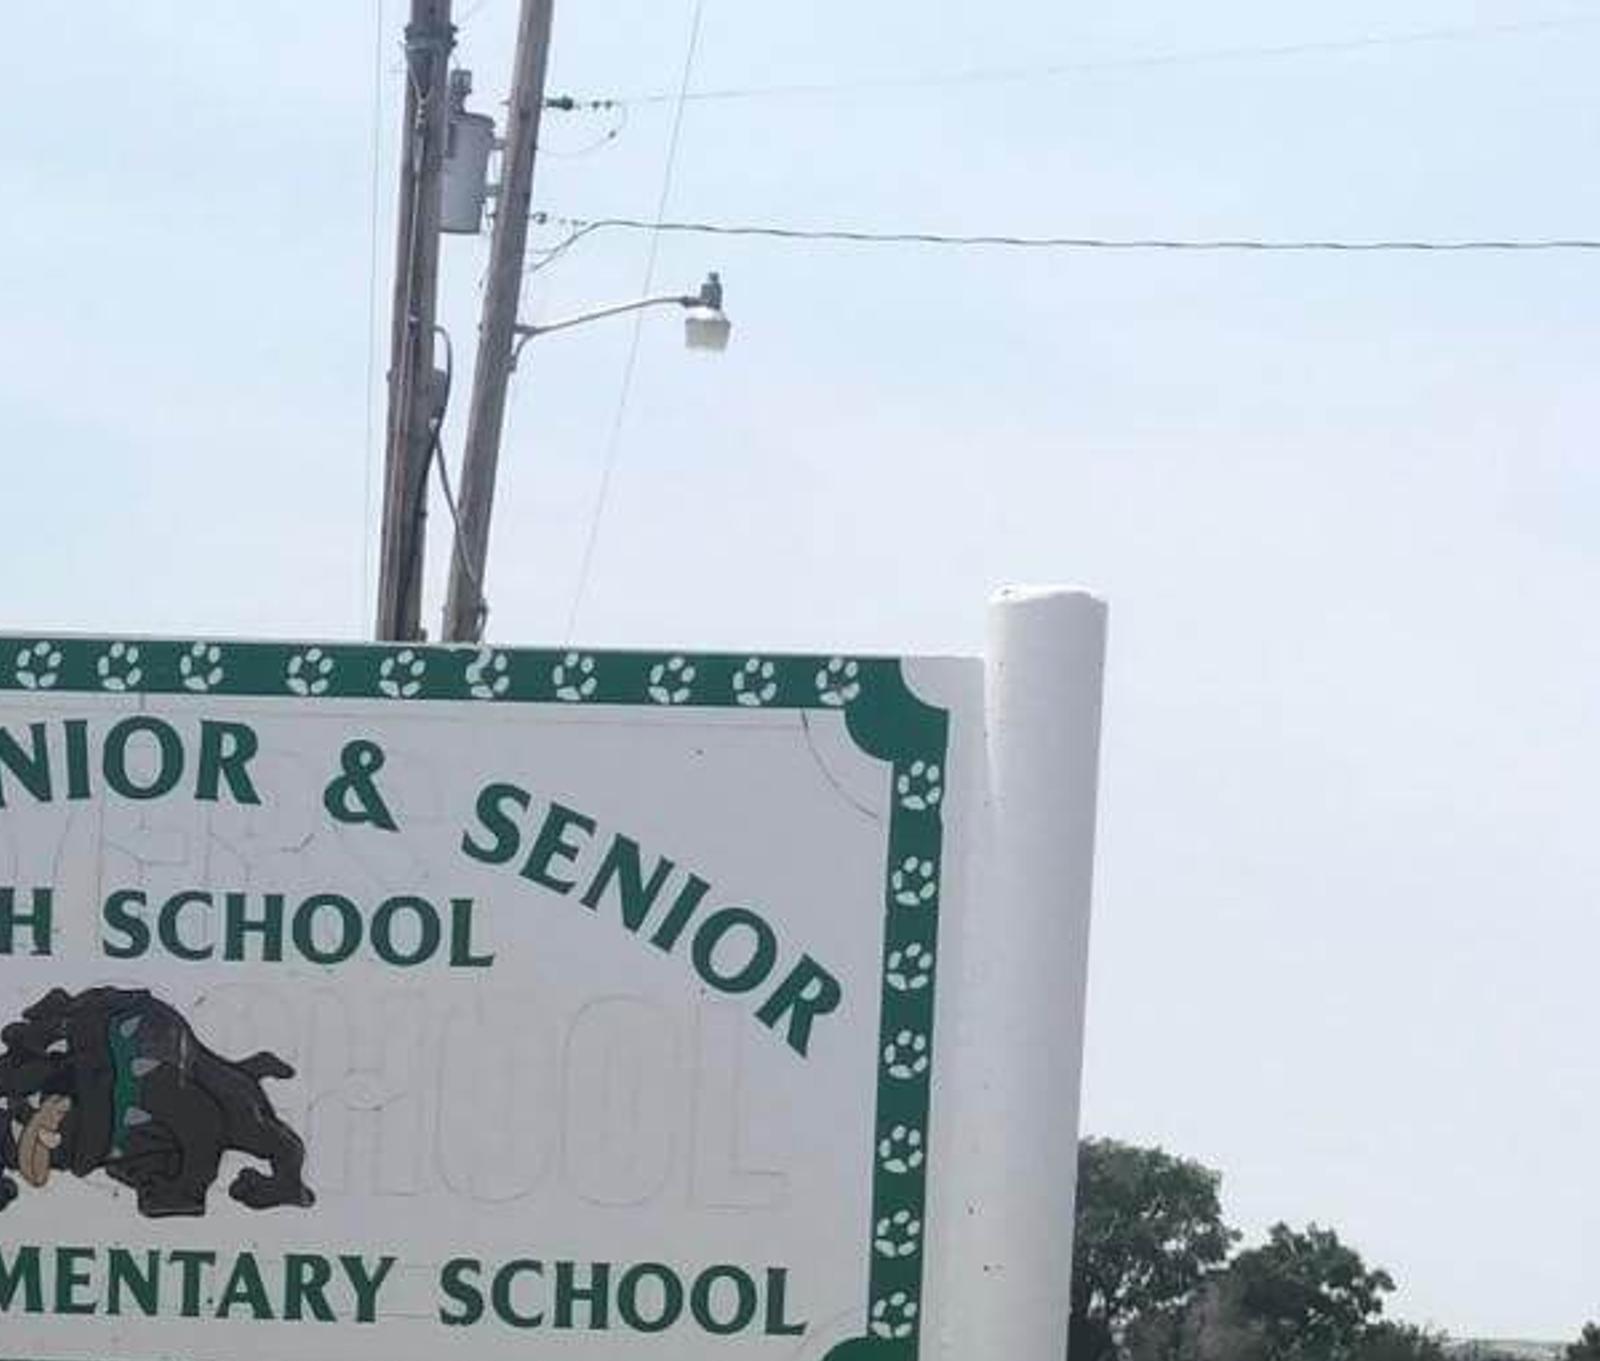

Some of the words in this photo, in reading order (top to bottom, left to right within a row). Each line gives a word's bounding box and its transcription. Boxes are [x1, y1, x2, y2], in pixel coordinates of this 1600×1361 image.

[102, 889, 496, 969] SCHOOL
[322, 737, 398, 832] &
[458, 781, 845, 1060] SENIOR
[438, 1258, 809, 1338] SCHOOL
